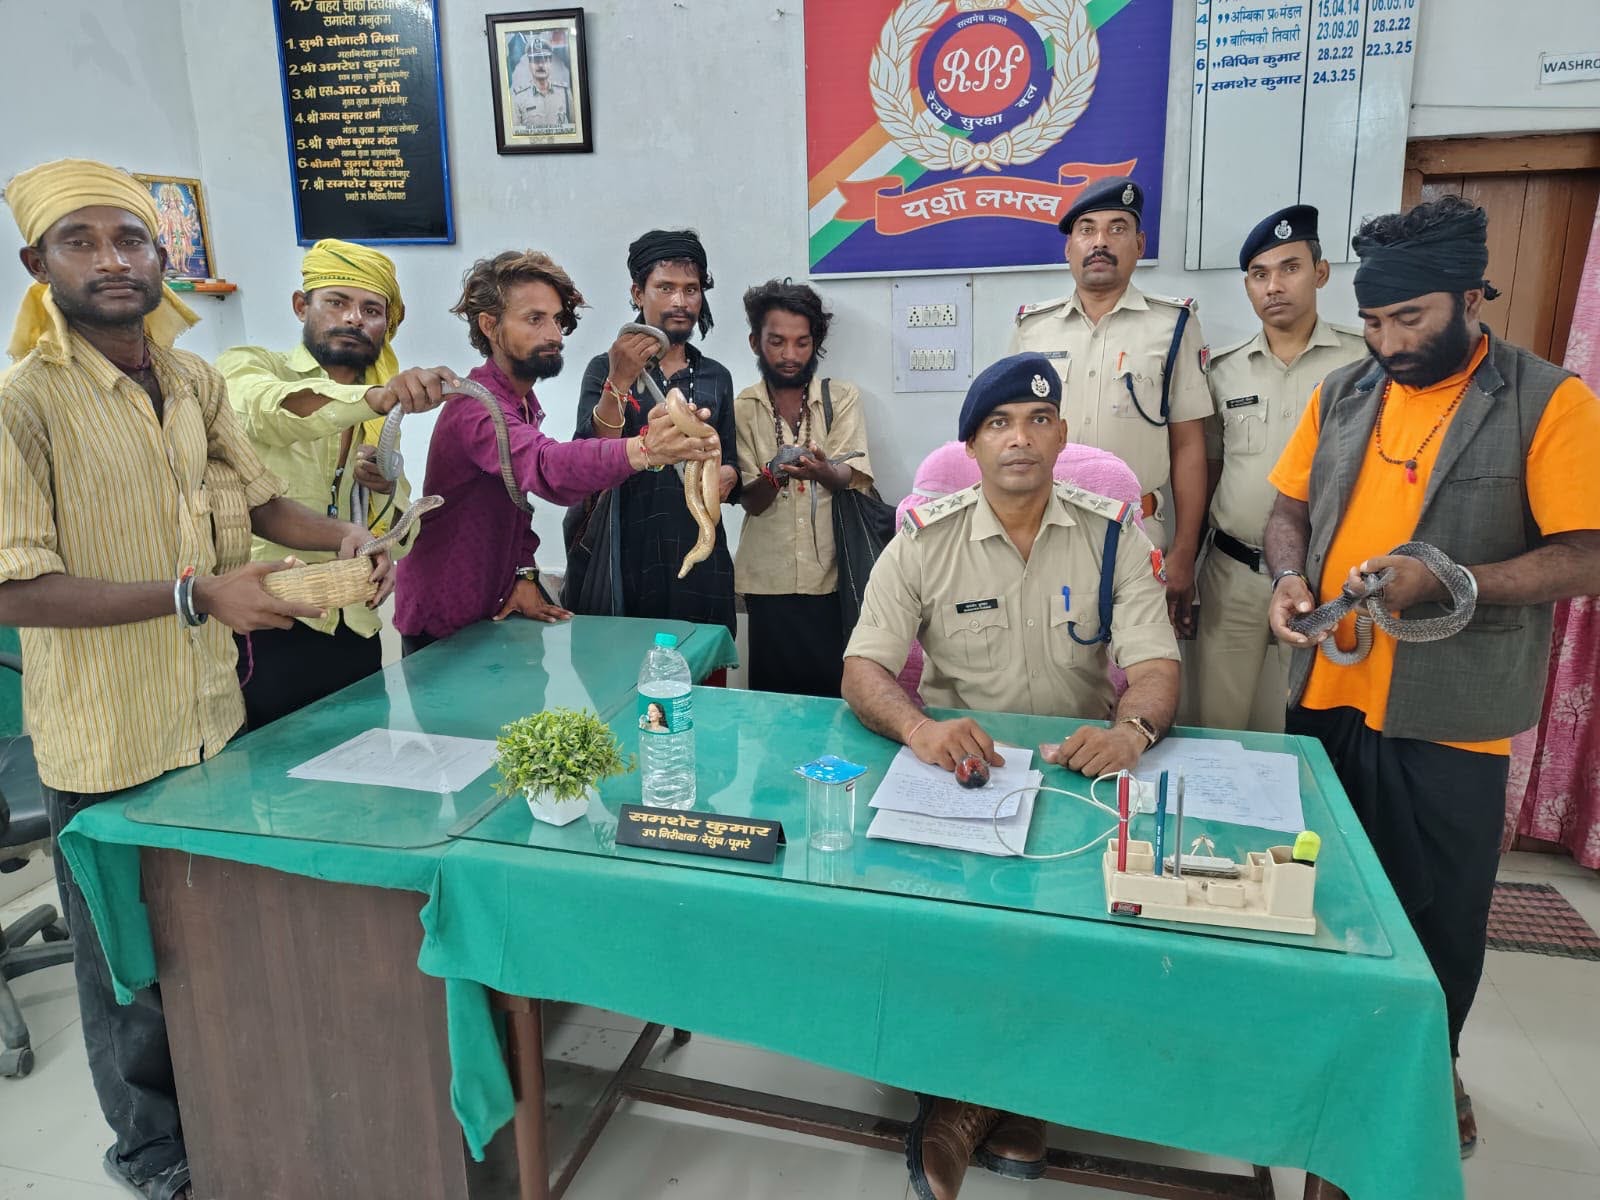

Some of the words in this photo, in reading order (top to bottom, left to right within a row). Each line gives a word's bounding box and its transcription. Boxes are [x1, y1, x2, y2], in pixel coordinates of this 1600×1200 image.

[322, 12, 356, 27] समादेश
[358, 14, 391, 29] अनुक्रम
[956, 13, 984, 29] सत्यमेव
[988, 14, 1008, 27] जयते
[1196, 13, 1209, 25] 4
[1318, 0, 1360, 17] 15.04.14
[298, 35, 324, 52] सुश्री
[327, 33, 368, 47] सोनाली
[370, 32, 400, 44] मिश्रा
[1196, 39, 1208, 51] 5
[1272, 24, 1301, 43] तिवारी
[1316, 20, 1359, 40] 23.09.20
[1373, 17, 1411, 33] 28.2.22
[300, 62, 317, 73] श्री
[318, 60, 360, 72] अमरेश
[363, 58, 400, 73] कुमार
[1196, 58, 1206, 71] 6
[1262, 51, 1302, 69] कुमार
[1317, 46, 1354, 61] 28.2.22
[1366, 40, 1412, 57] 22.3.25
[304, 85, 316, 100] श्री
[369, 79, 400, 94] गाँधी
[1195, 83, 1204, 95] 7
[1211, 76, 1259, 91] समशेर
[1260, 75, 1303, 91] कुमार
[1312, 69, 1356, 84] 24.3.25
[307, 109, 318, 124] श्री
[319, 111, 340, 121] अजय
[341, 111, 363, 124] कुमार
[364, 108, 380, 120] शर्मा
[926, 90, 953, 121] रेलवे
[959, 113, 1003, 131] सुरक्षा
[1014, 83, 1038, 108] बल
[308, 134, 322, 150] श्री
[326, 136, 351, 150] सुशील
[352, 137, 375, 149] कुमार
[377, 135, 398, 146] मंडल
[310, 158, 341, 169] श्रीमती
[343, 159, 370, 171] सुमन
[372, 157, 403, 170] कुमारी
[300, 179, 312, 190] 7.
[313, 177, 325, 191] श्री
[325, 177, 367, 188] समशेर
[369, 179, 406, 192] कुमार
[901, 187, 968, 220] यशो
[976, 188, 1062, 217] लभस्व
[628, 811, 702, 829] समशेर
[705, 820, 772, 837] कुमार
[641, 828, 657, 838] उप
